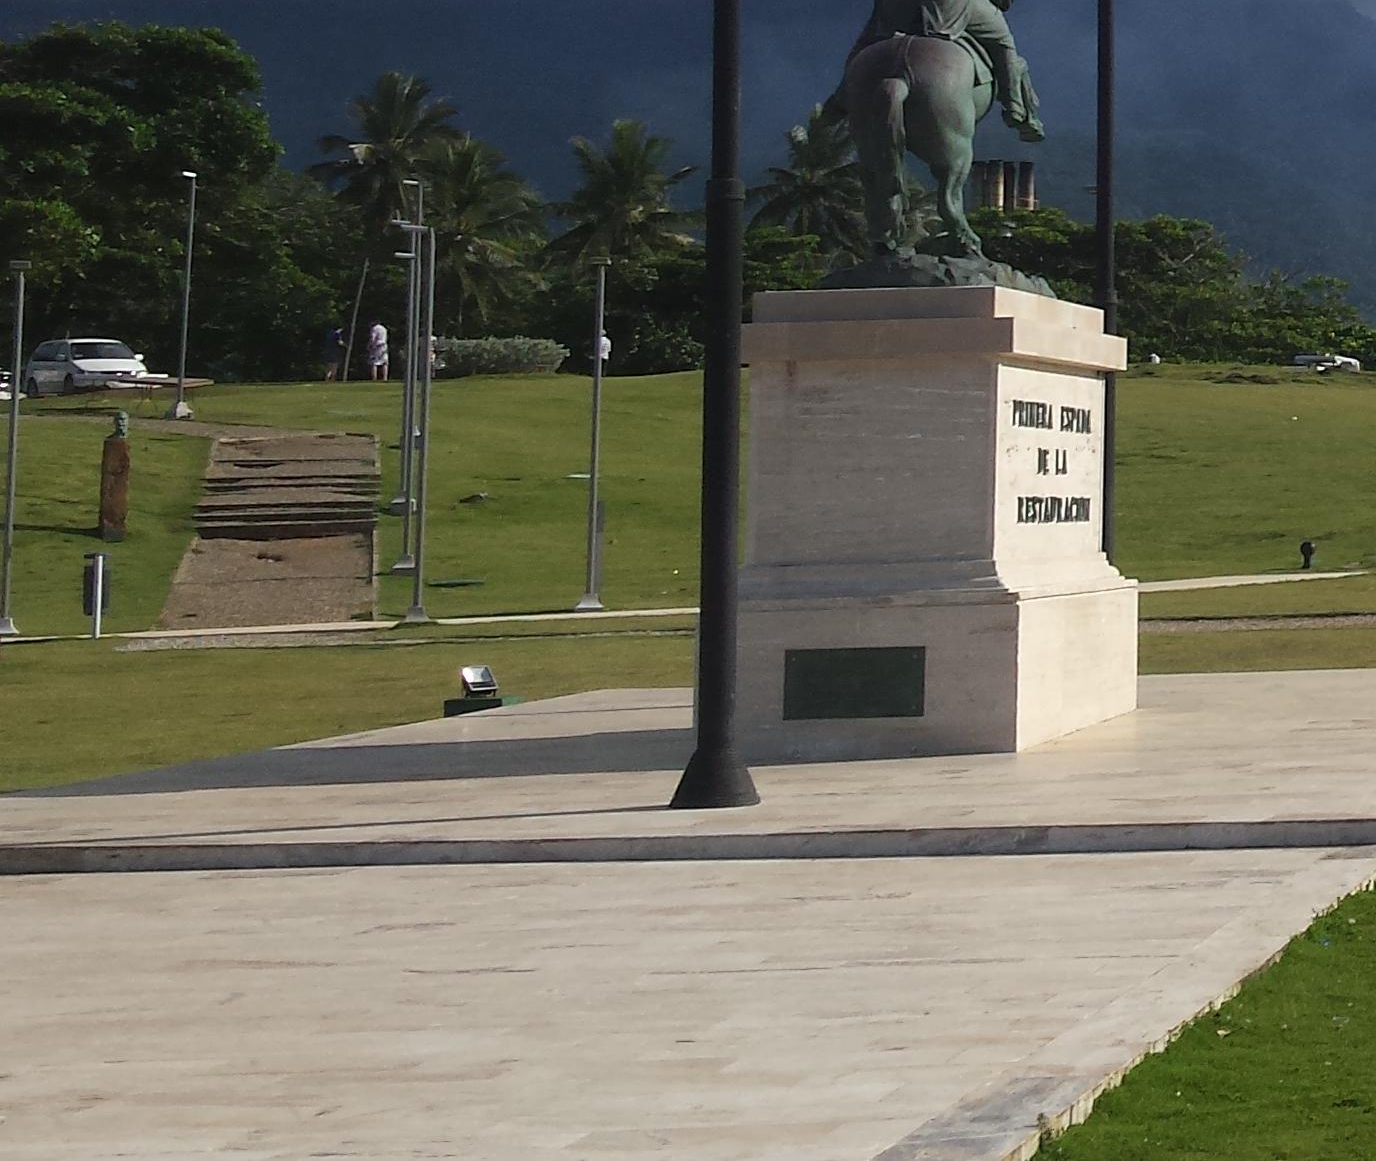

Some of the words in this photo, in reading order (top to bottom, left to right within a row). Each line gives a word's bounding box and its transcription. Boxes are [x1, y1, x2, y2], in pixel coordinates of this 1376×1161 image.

[1012, 399, 1053, 429] PRIMERA
[1060, 406, 1092, 434] ESPADA
[1036, 447, 1050, 475] DE
[1055, 448, 1068, 475] LA
